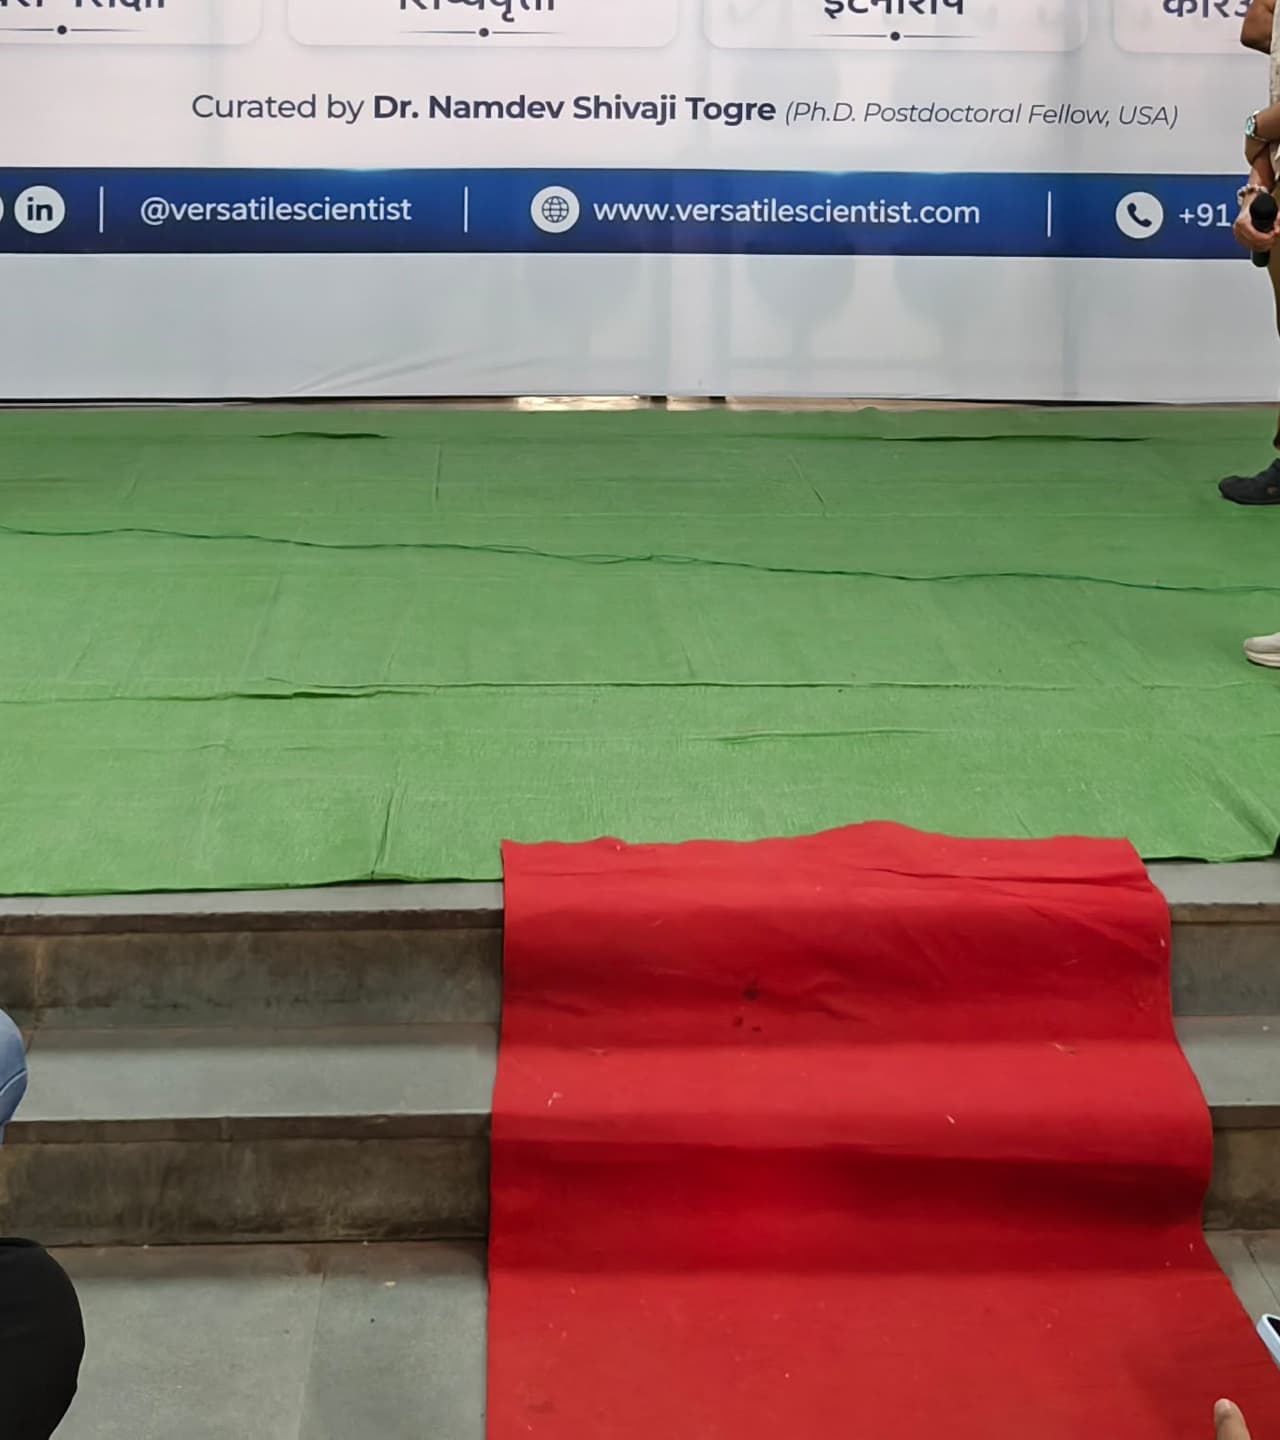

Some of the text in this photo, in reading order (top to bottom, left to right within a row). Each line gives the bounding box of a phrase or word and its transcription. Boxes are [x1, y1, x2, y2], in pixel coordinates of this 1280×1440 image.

[191, 93, 1180, 131] Curated by Dr. Namdev Shivaji Togre (Ph.D. Postdoctoral Fellow, USA)
[27, 196, 54, 222] in
[140, 196, 413, 226] @versatilescientist
[593, 197, 980, 225] www.versatilescientist.com
[1178, 202, 1232, 227] +91
